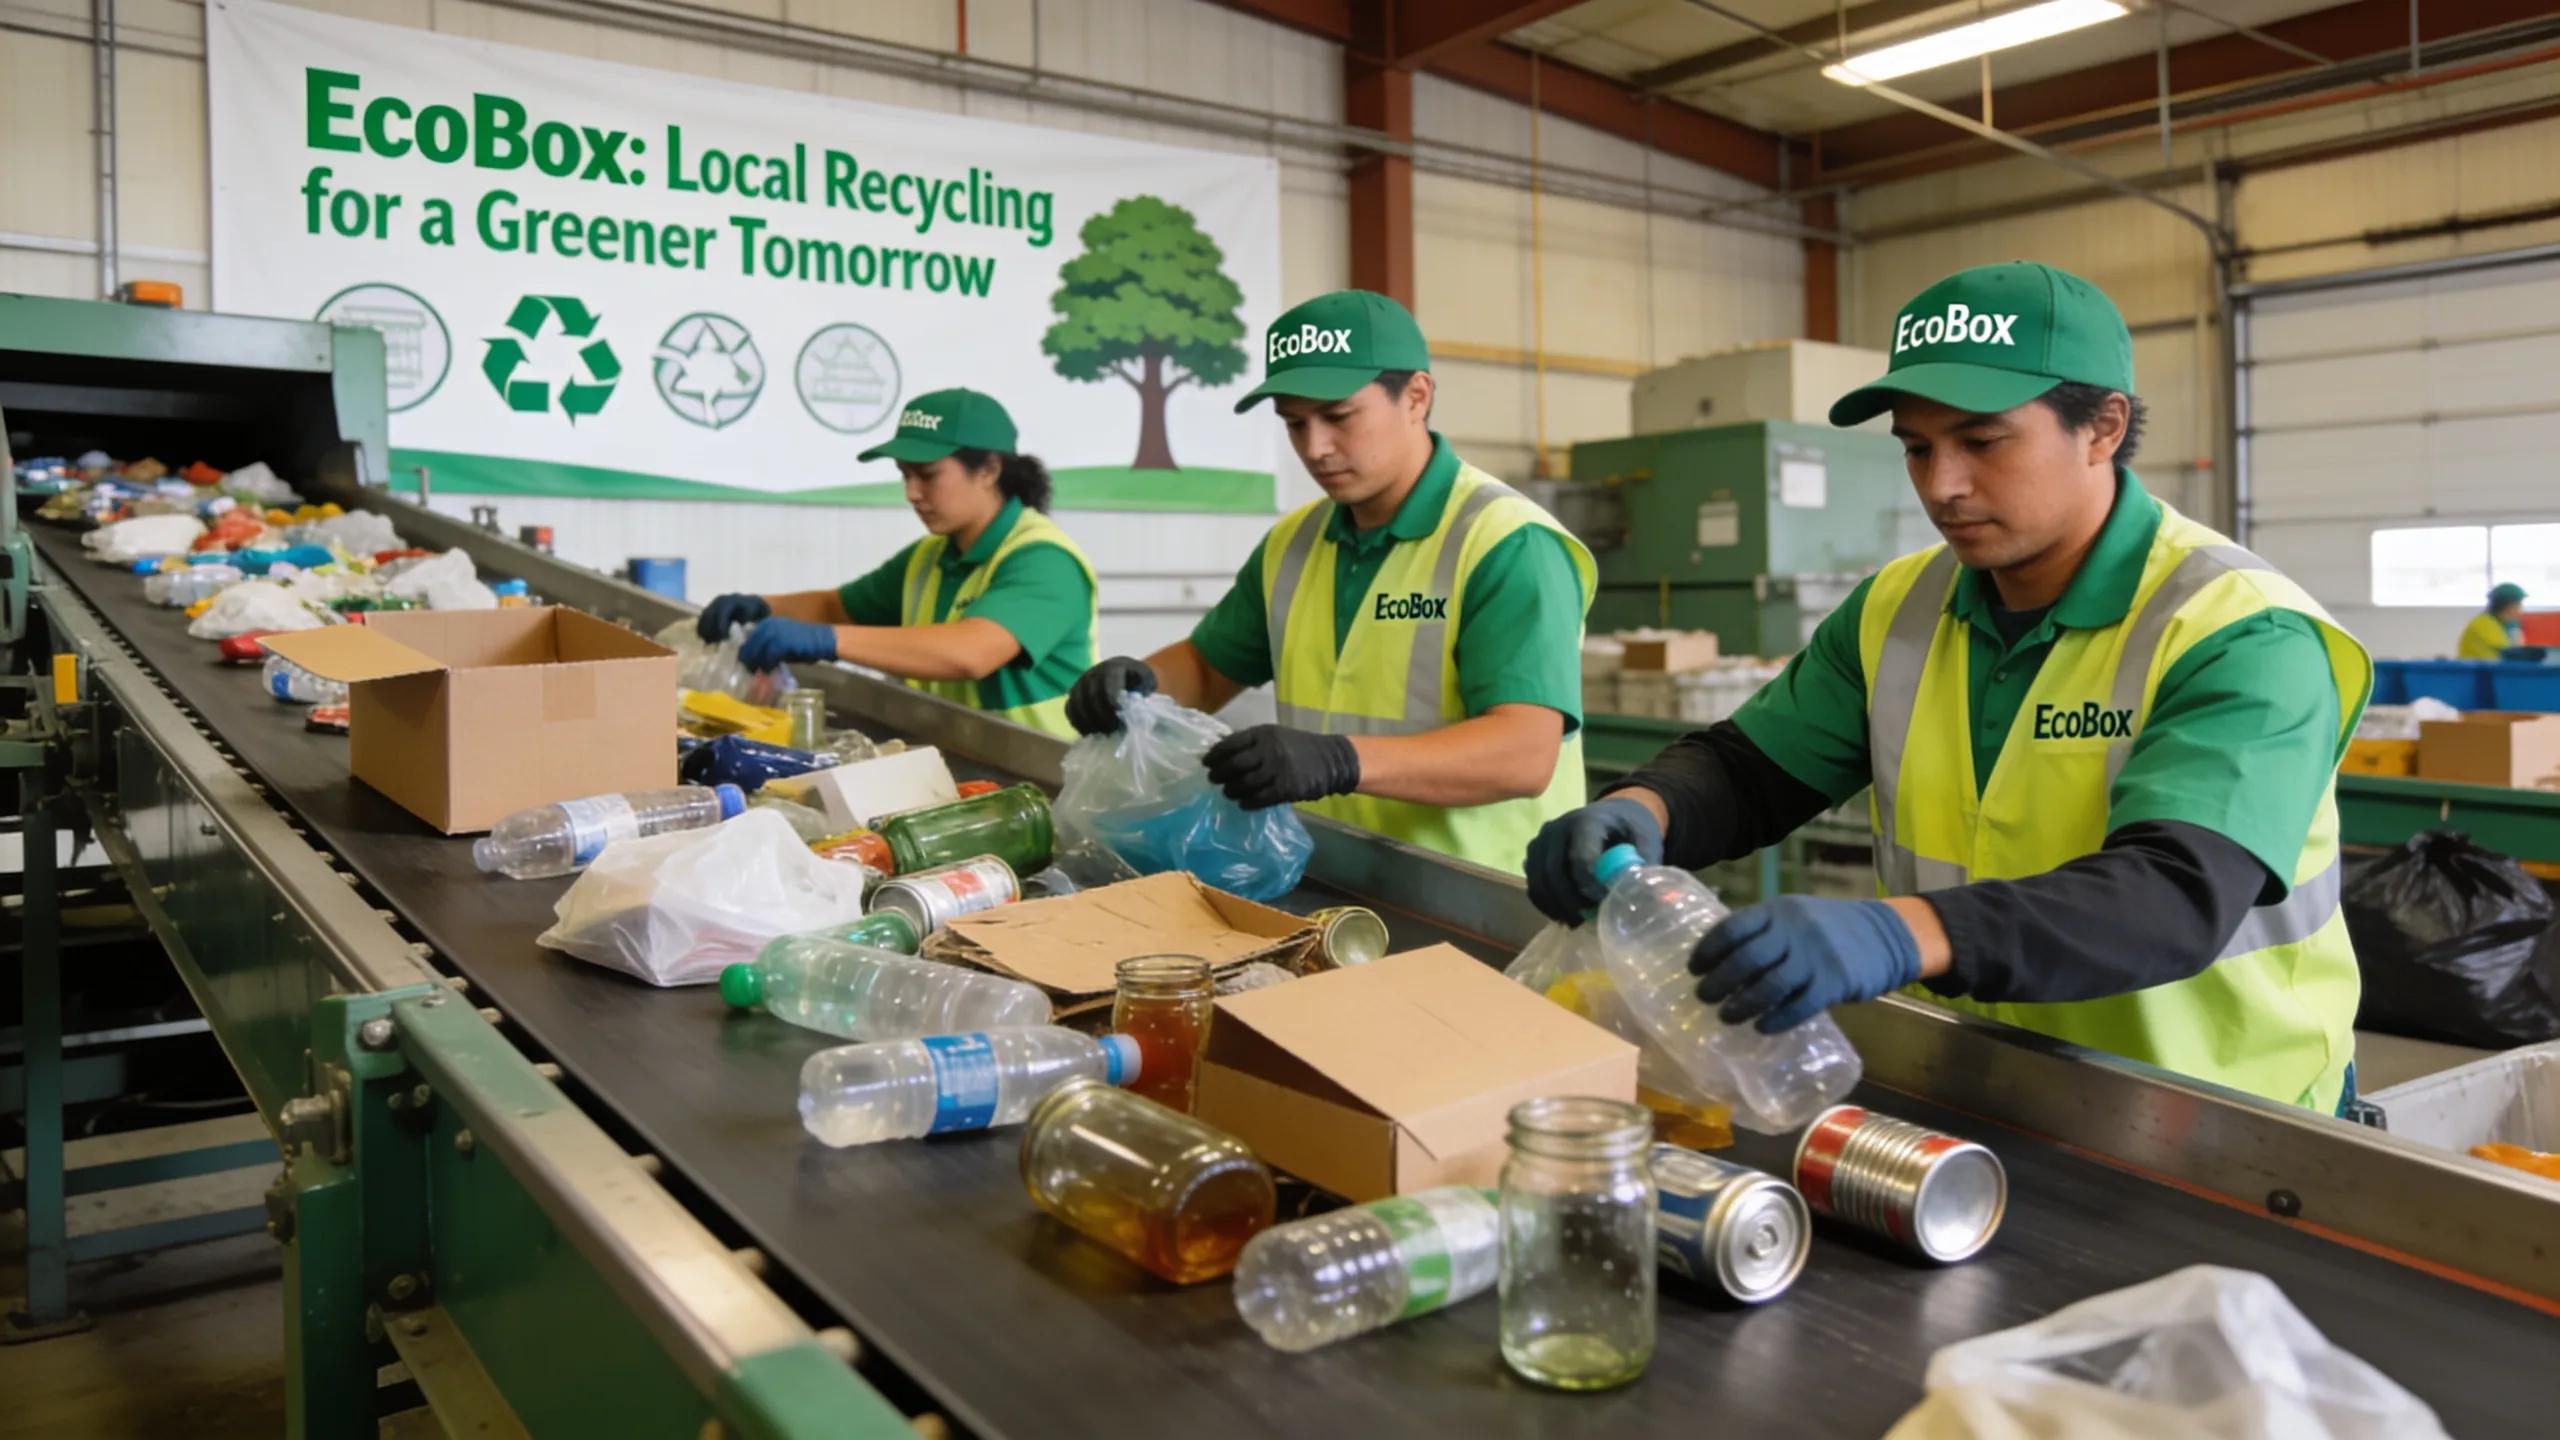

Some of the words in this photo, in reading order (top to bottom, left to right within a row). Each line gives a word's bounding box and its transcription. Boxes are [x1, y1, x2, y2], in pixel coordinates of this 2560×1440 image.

[306, 68, 647, 186] EcoBox:
[667, 125, 807, 203] Local
[825, 150, 1054, 248] Recycling
[301, 166, 401, 239] for
[420, 198, 455, 246] a
[477, 189, 717, 270] Greener
[729, 215, 996, 298] Tomorrow
[1269, 324, 1352, 363] EcoBox
[1896, 304, 2018, 354] EcoBox
[1375, 593, 1447, 620] EcoBox
[2034, 702, 2133, 739] EcoBox
